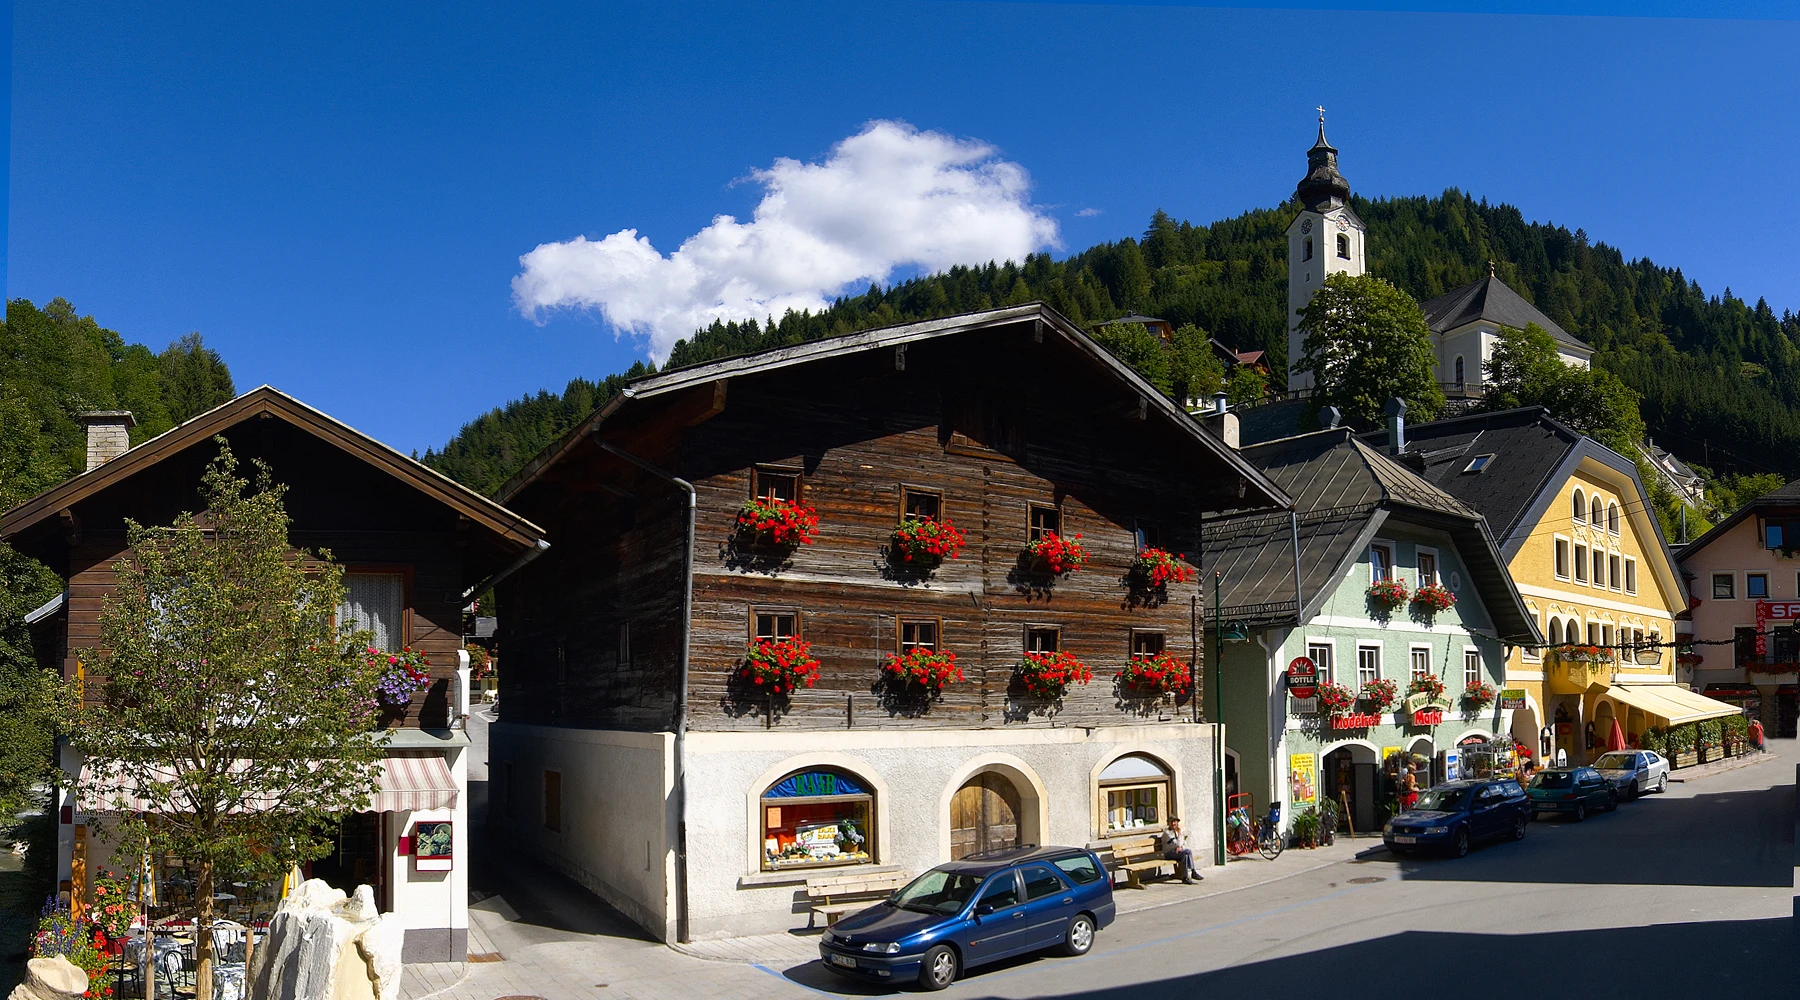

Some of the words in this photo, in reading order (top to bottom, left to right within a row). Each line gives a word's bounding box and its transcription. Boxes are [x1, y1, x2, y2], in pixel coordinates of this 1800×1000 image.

[1290, 676, 1314, 684] BOTTLE
[1414, 709, 1443, 726] Markt
[796, 774, 835, 795] RAAB
